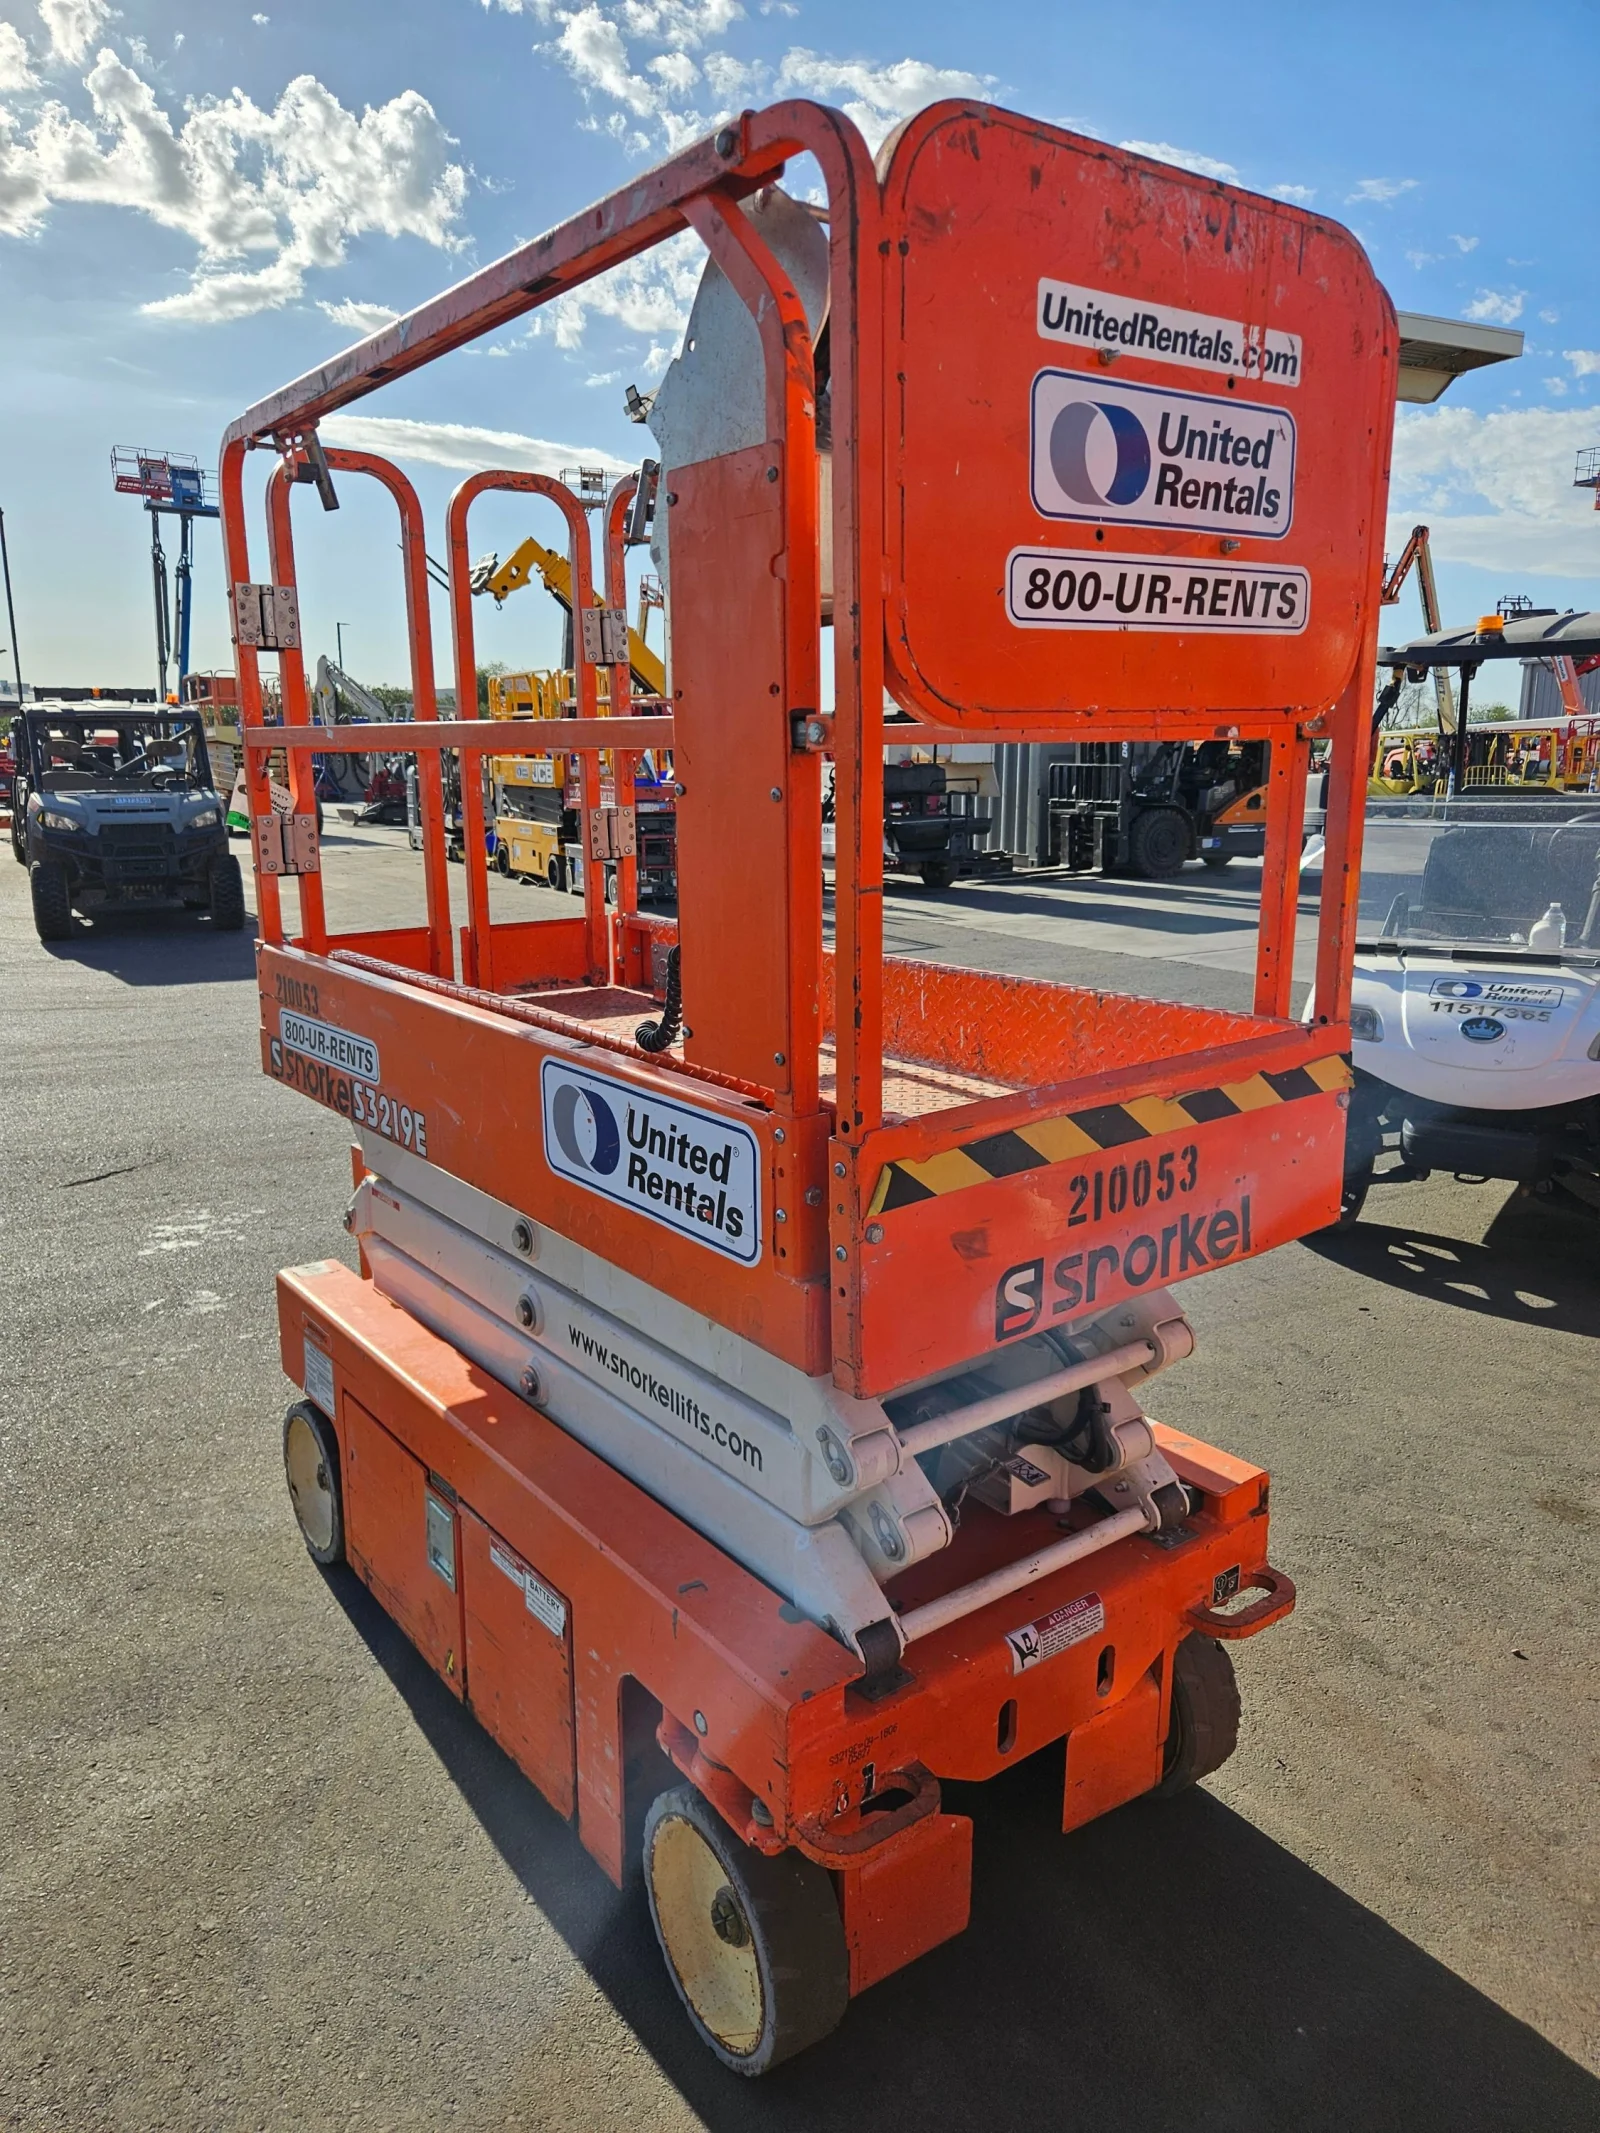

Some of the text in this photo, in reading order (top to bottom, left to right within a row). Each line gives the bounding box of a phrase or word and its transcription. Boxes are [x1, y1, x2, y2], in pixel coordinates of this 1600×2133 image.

[1042, 291, 1298, 378] UnitedRentals.com
[1156, 412, 1276, 470] United
[1154, 463, 1281, 519] Rentals
[1024, 567, 1298, 620] 800-UR-RENTS
[532, 764, 554, 783] JCB
[276, 974, 319, 1015] 210053
[1488, 984, 1553, 997] United
[285, 1019, 373, 1074] 800-UR-RENTS
[352, 1079, 428, 1158] S3219E
[627, 1108, 732, 1185] United
[628, 1152, 744, 1238] Rentals
[1067, 1144, 1199, 1228] 210053
[568, 1323, 764, 1472] www.snorkellifts.com
[529, 1579, 560, 1612] BATTERY
[1053, 1599, 1089, 1622] DANGER
